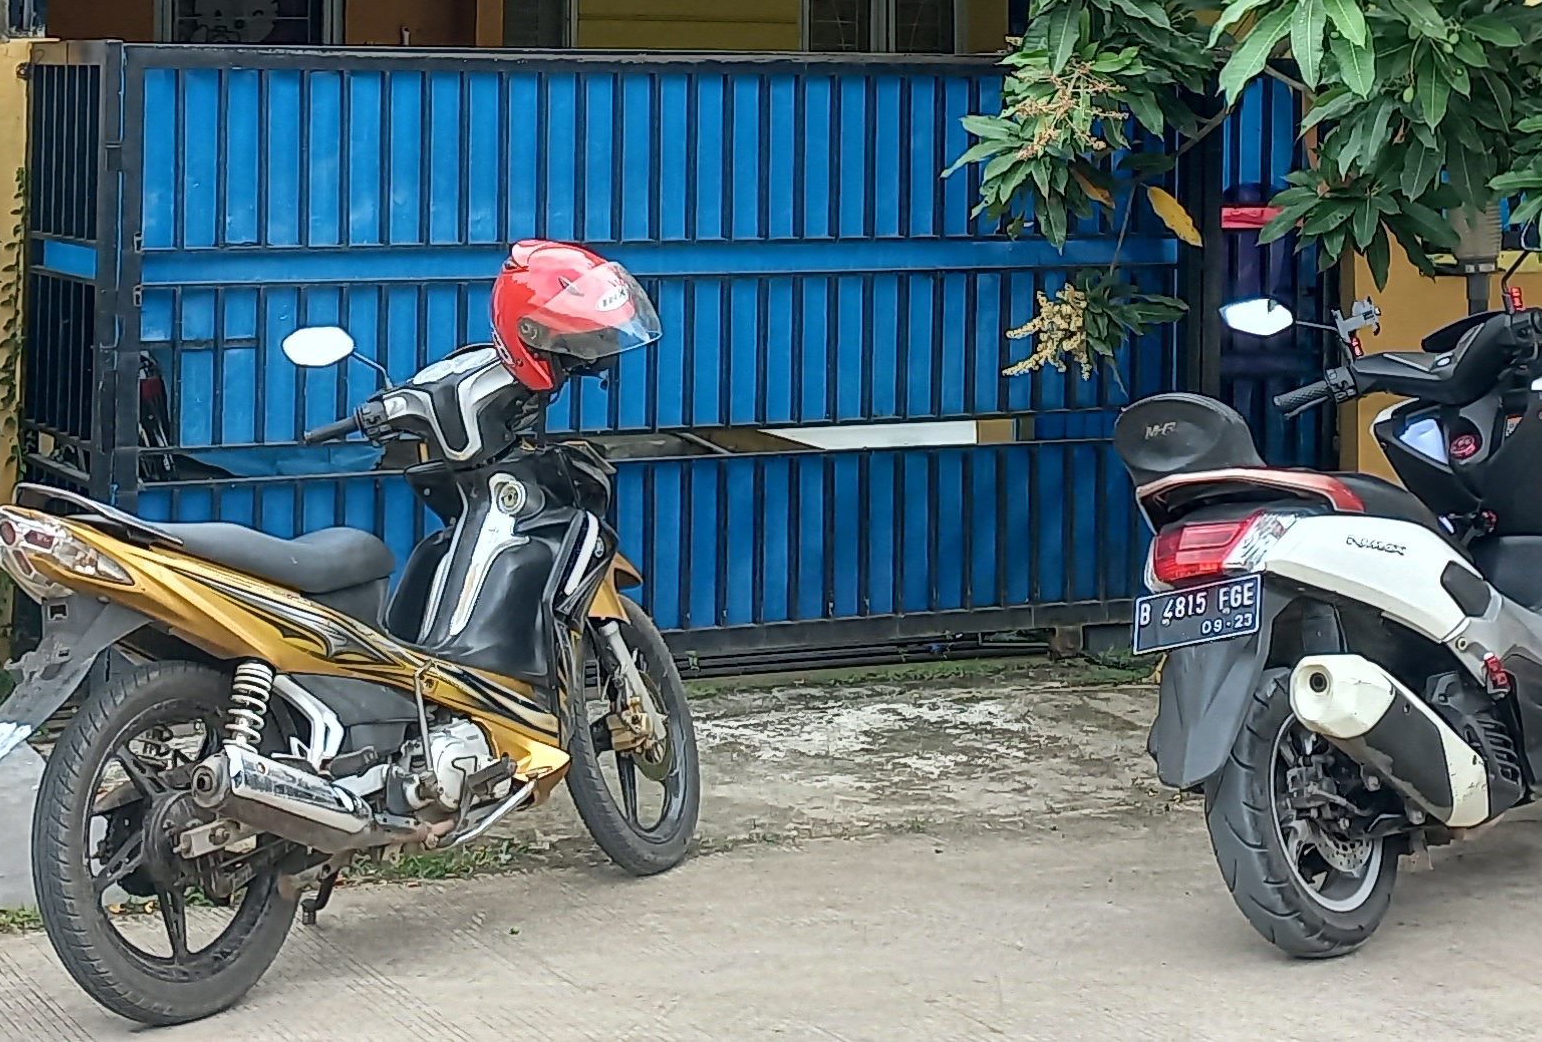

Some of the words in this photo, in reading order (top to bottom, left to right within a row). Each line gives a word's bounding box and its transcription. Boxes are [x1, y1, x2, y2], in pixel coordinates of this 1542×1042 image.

[1139, 602, 1151, 626] B
[1162, 591, 1208, 619] 4815
[1218, 582, 1255, 610] FGE
